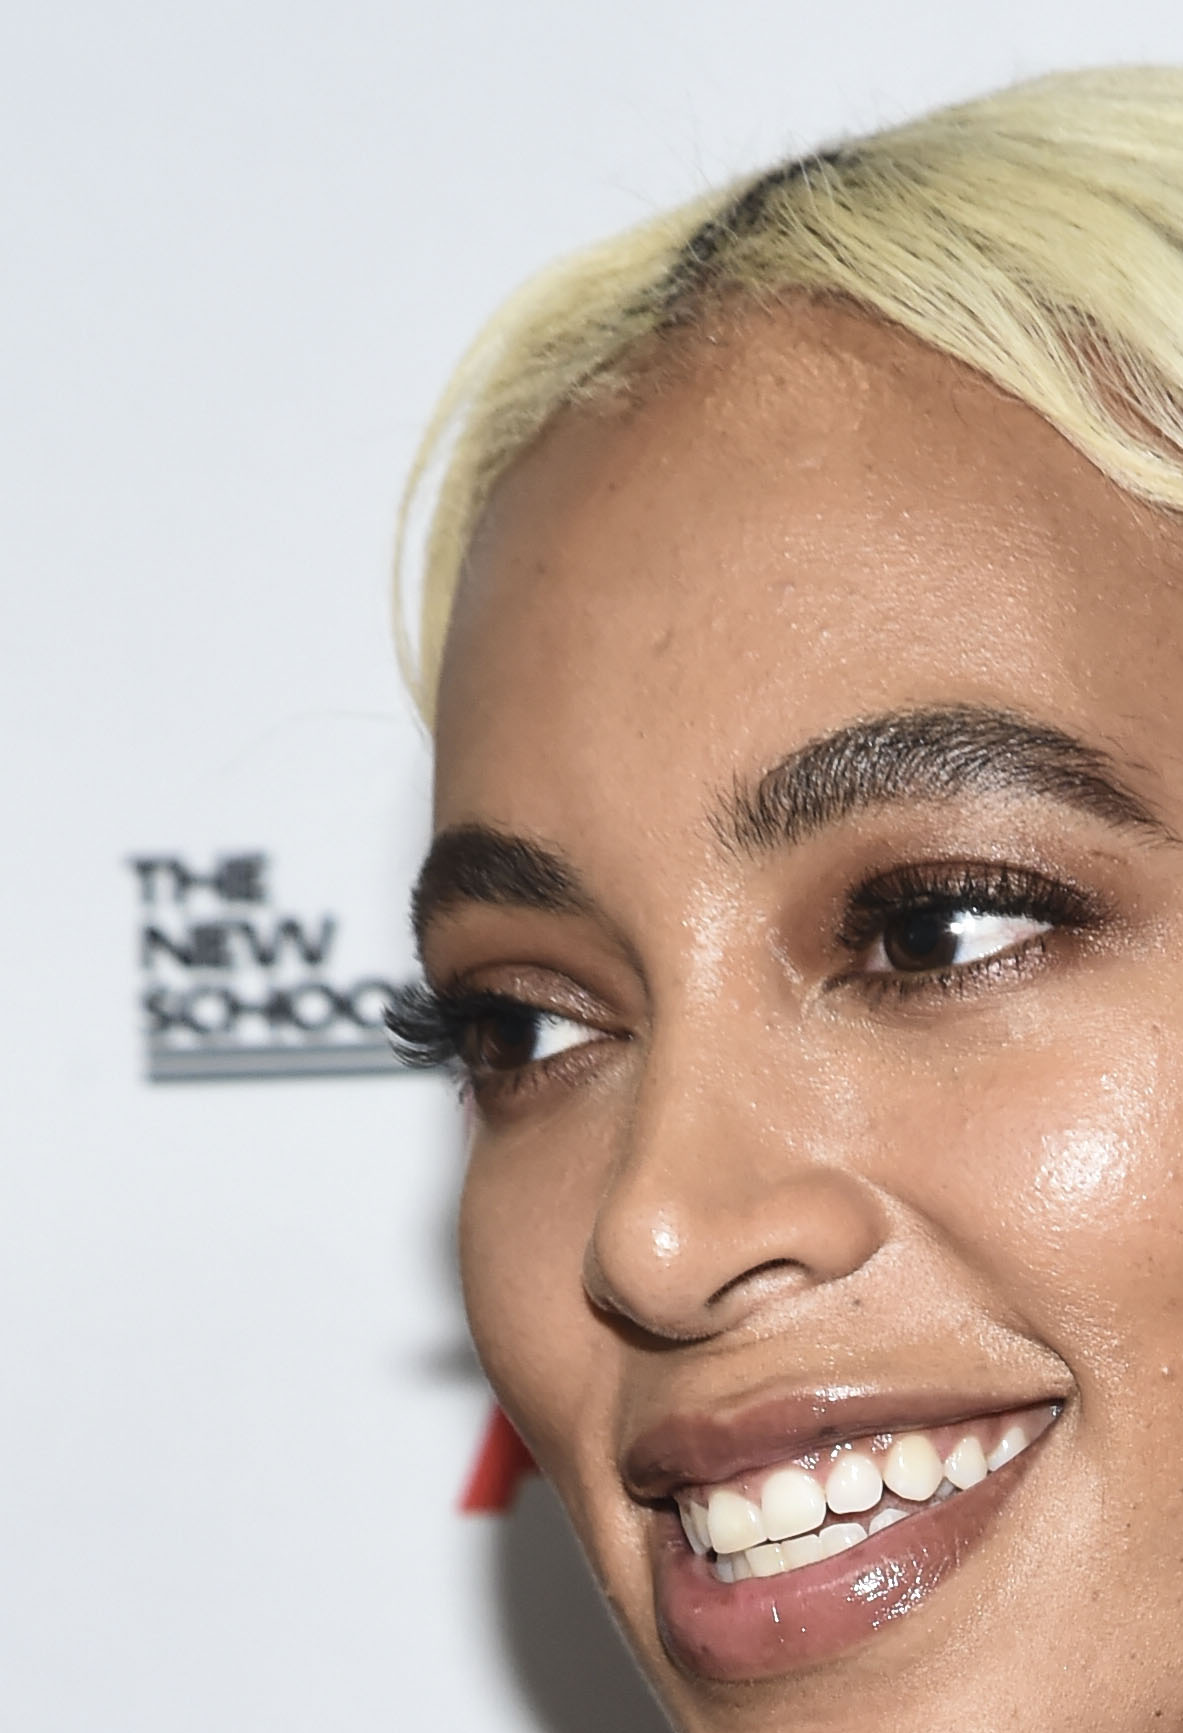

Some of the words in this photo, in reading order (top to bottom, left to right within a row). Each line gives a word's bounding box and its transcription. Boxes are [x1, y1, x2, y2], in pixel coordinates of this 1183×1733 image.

[134, 854, 267, 904] THE
[142, 913, 336, 967] NEW
[142, 976, 406, 1033] SCHOO
